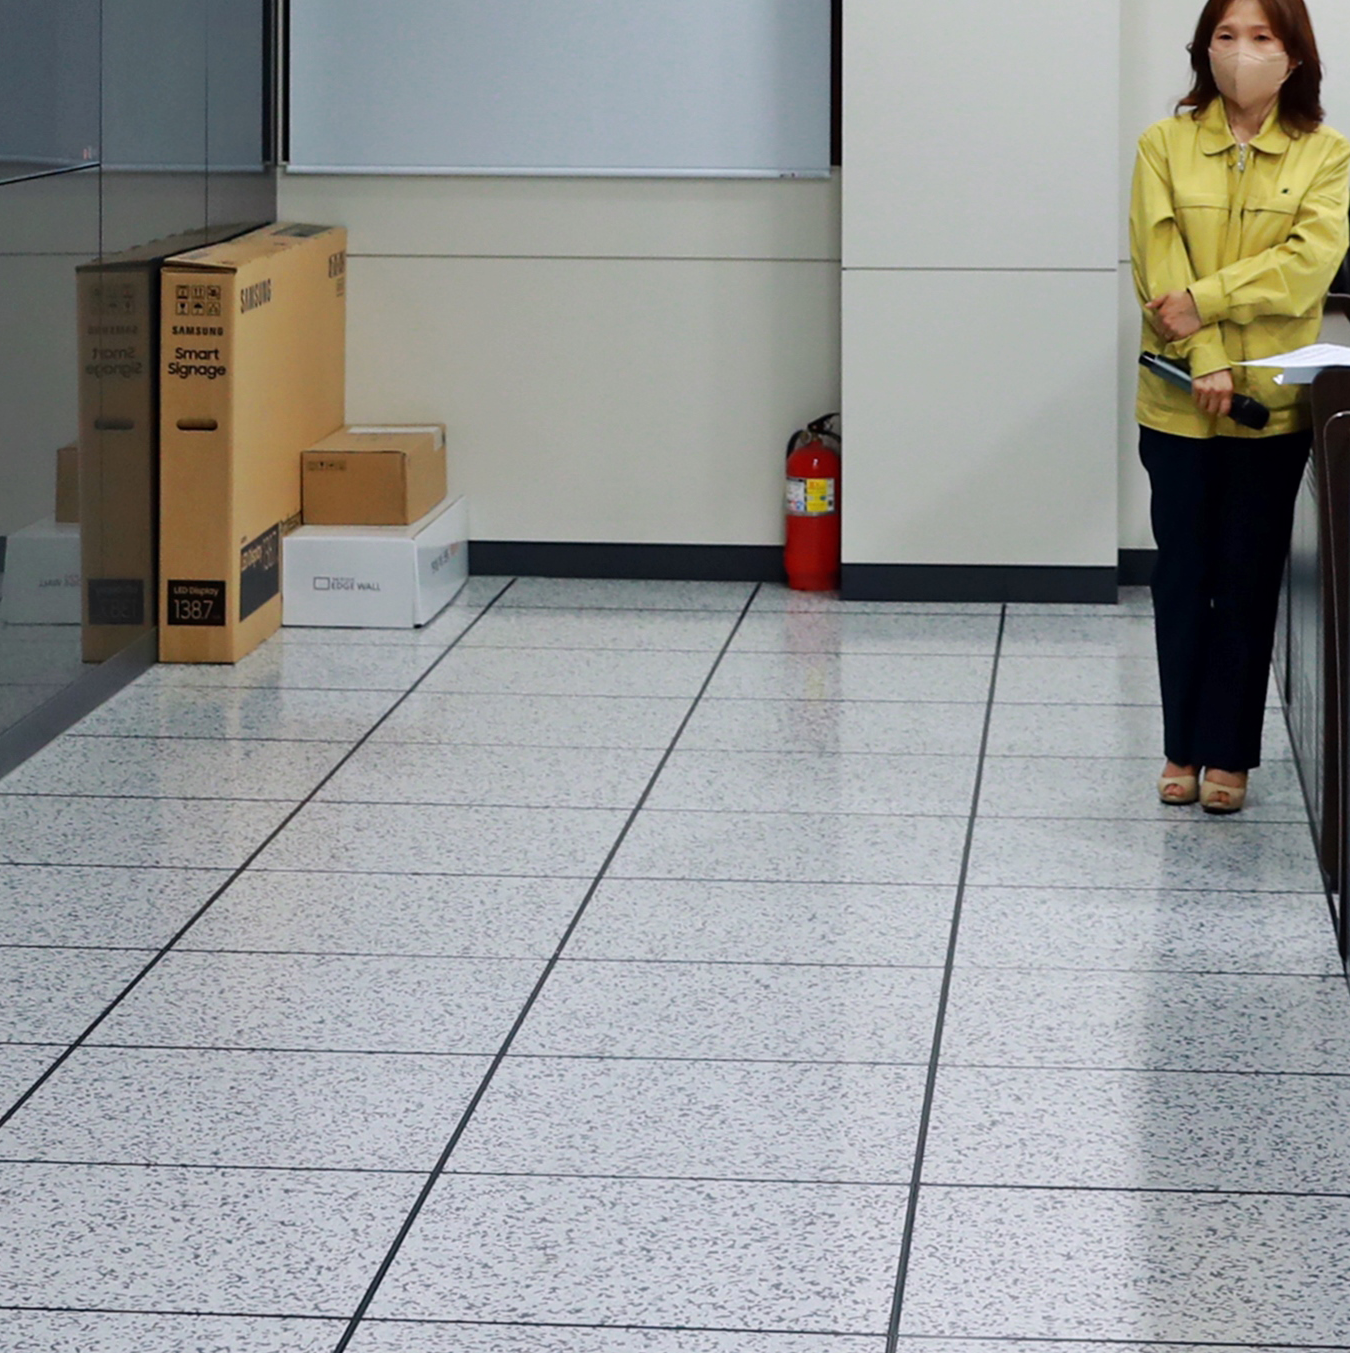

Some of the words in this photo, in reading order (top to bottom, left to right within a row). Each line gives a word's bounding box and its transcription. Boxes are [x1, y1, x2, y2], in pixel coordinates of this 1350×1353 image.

[171, 325, 224, 336] SAMSUNG
[175, 346, 220, 361] Smart
[168, 361, 227, 380] Signage
[173, 586, 188, 595] LED
[189, 586, 220, 597] Display
[332, 582, 355, 591] EDGE
[357, 583, 382, 592] WALL
